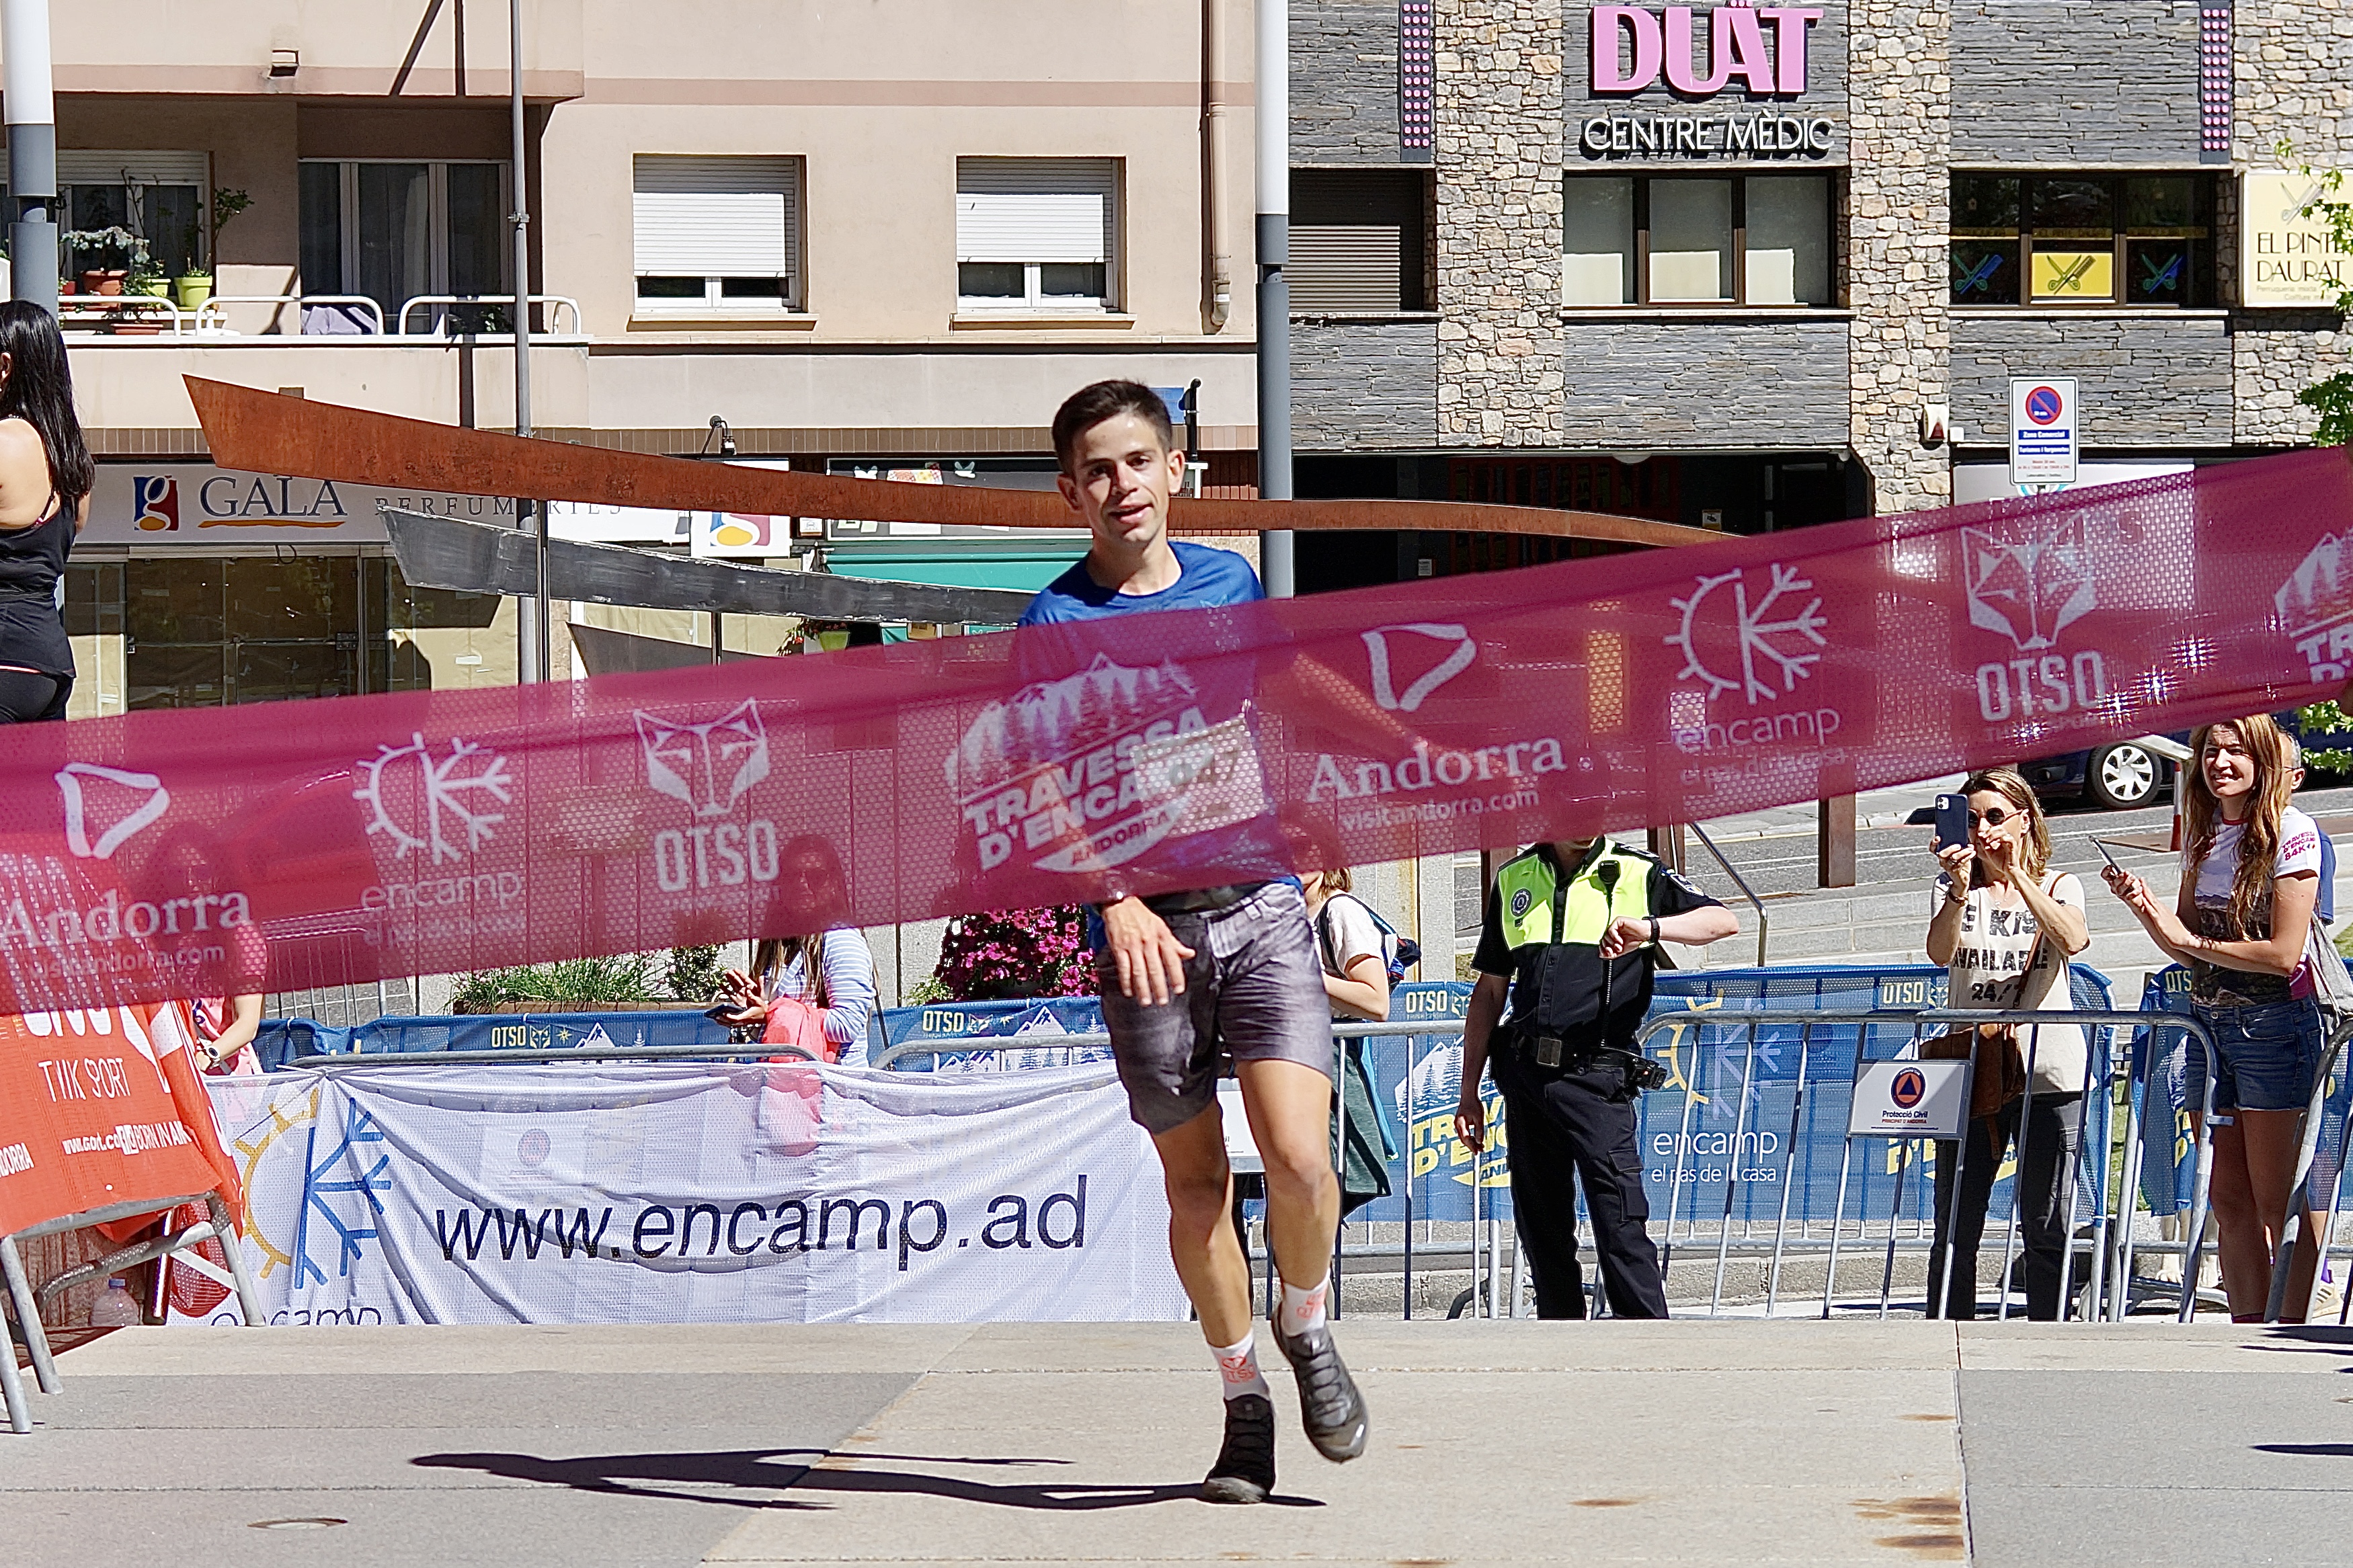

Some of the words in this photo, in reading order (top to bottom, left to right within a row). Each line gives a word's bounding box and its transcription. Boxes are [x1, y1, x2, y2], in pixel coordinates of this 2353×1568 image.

[1584, 117, 1715, 151] CENTRE
[2258, 233, 2281, 253] EL
[2257, 260, 2346, 282] DAURAT
[201, 476, 348, 517] GALA
[1975, 649, 2107, 723] OTSO
[1675, 707, 1841, 753] encamp
[963, 706, 1211, 837] TRAVESSA
[1304, 737, 1568, 803] Andorra
[1341, 788, 1540, 831] visitandorra.com
[654, 819, 781, 893] OTSO
[360, 872, 523, 909] encamp
[1, 887, 255, 950] Andorra
[1882, 981, 1924, 1005] OTSO
[1971, 982, 2020, 1003] 24/
[2165, 971, 2192, 992] OTS
[1406, 990, 1447, 1014] OTSO
[491, 1025, 526, 1048] OTSO
[922, 1010, 965, 1032] OTSO
[1882, 1110, 1913, 1118] Protecció
[1653, 1131, 1778, 1164] encamp
[1652, 1163, 1666, 1182] el
[1700, 1163, 1722, 1182] de
[1741, 1168, 1777, 1182] casa
[436, 1173, 1087, 1272] www.encamp.ad
